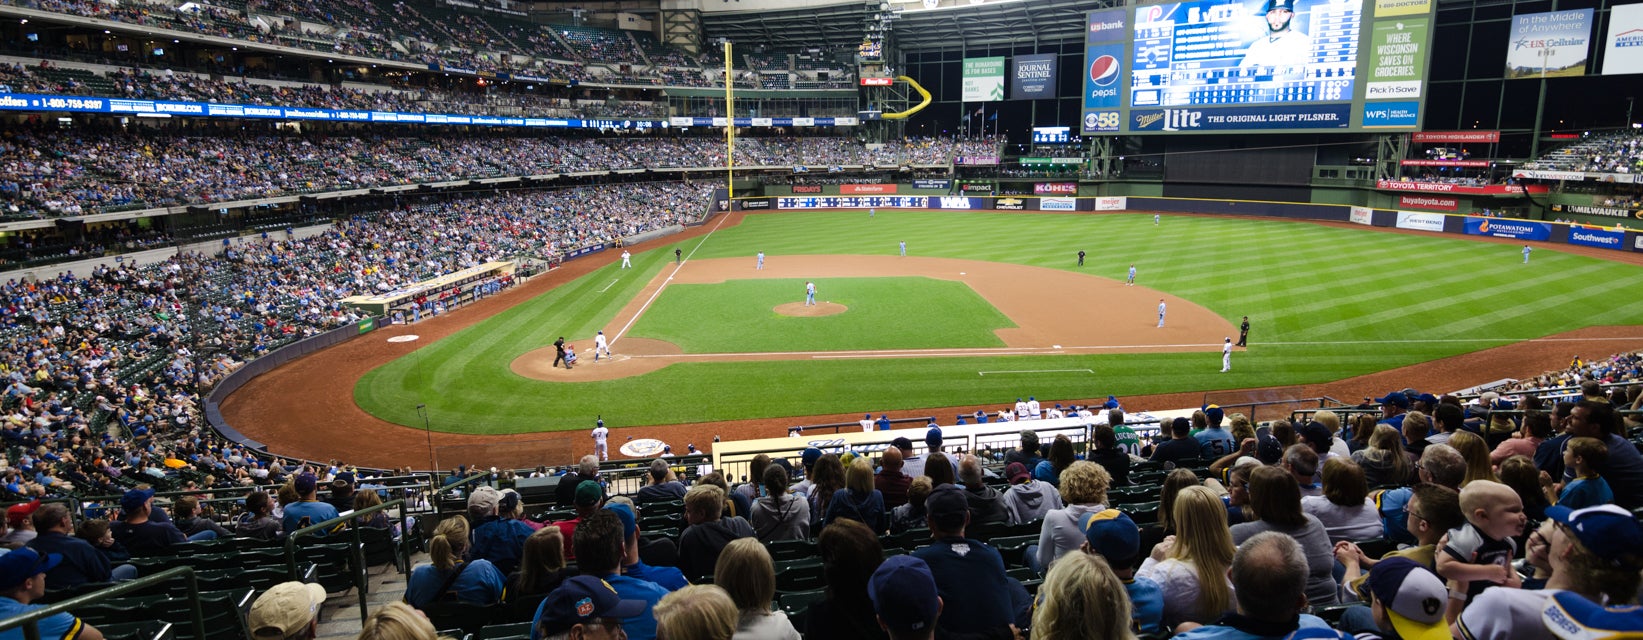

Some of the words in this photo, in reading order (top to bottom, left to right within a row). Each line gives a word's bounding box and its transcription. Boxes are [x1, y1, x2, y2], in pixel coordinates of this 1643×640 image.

[1551, 12, 1584, 22] Middle
[1531, 22, 1583, 33] Anywhere
[1386, 32, 1412, 44] WHERE
[1378, 44, 1418, 55] WISCONSIN
[1379, 56, 1401, 66] SAVES
[1402, 54, 1414, 64] ON
[1018, 64, 1051, 72] JOURNAL
[1375, 66, 1416, 78] GROCERIES.
[1018, 70, 1051, 78] SENTINEL
[1092, 88, 1117, 98] pepsi
[1098, 112, 1120, 127] 58
[1298, 113, 1340, 121] PILSNER.
[1366, 110, 1386, 118] WPS
[1136, 113, 1164, 128] Miller
[1162, 108, 1202, 132] Lite
[1416, 183, 1453, 191] TERRITORY
[1402, 196, 1455, 206] buyatoyota.com
[1489, 224, 1534, 232] POTAWATOMI
[1573, 232, 1612, 244] Southwest
[1212, 438, 1233, 455] 51
[1544, 605, 1580, 634] BREWERS
